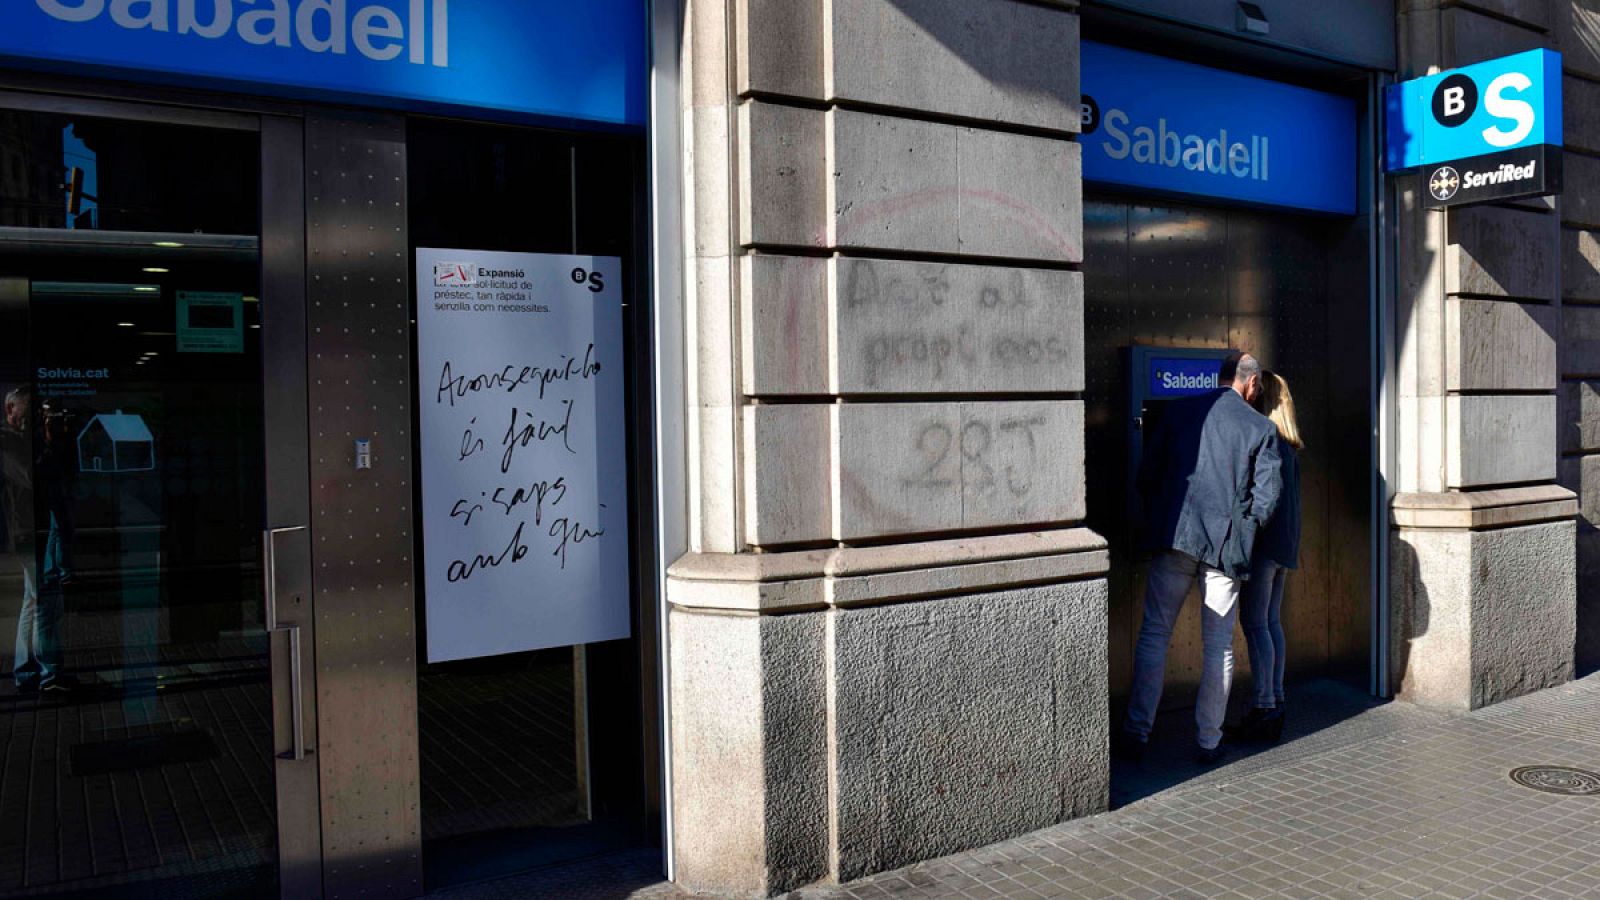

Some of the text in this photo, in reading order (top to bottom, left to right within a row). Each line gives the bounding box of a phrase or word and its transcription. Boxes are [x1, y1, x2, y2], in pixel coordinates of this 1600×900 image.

[36, 0, 449, 67] abadell
[1103, 108, 1269, 181] Sabadell
[1462, 160, 1536, 189] ServiRed
[478, 267, 525, 279] Expansió
[520, 280, 533, 290] de
[477, 291, 493, 301] tan
[473, 304, 495, 312] com
[37, 367, 110, 379] Solvia.cat
[1162, 371, 1219, 389] Sabadell
